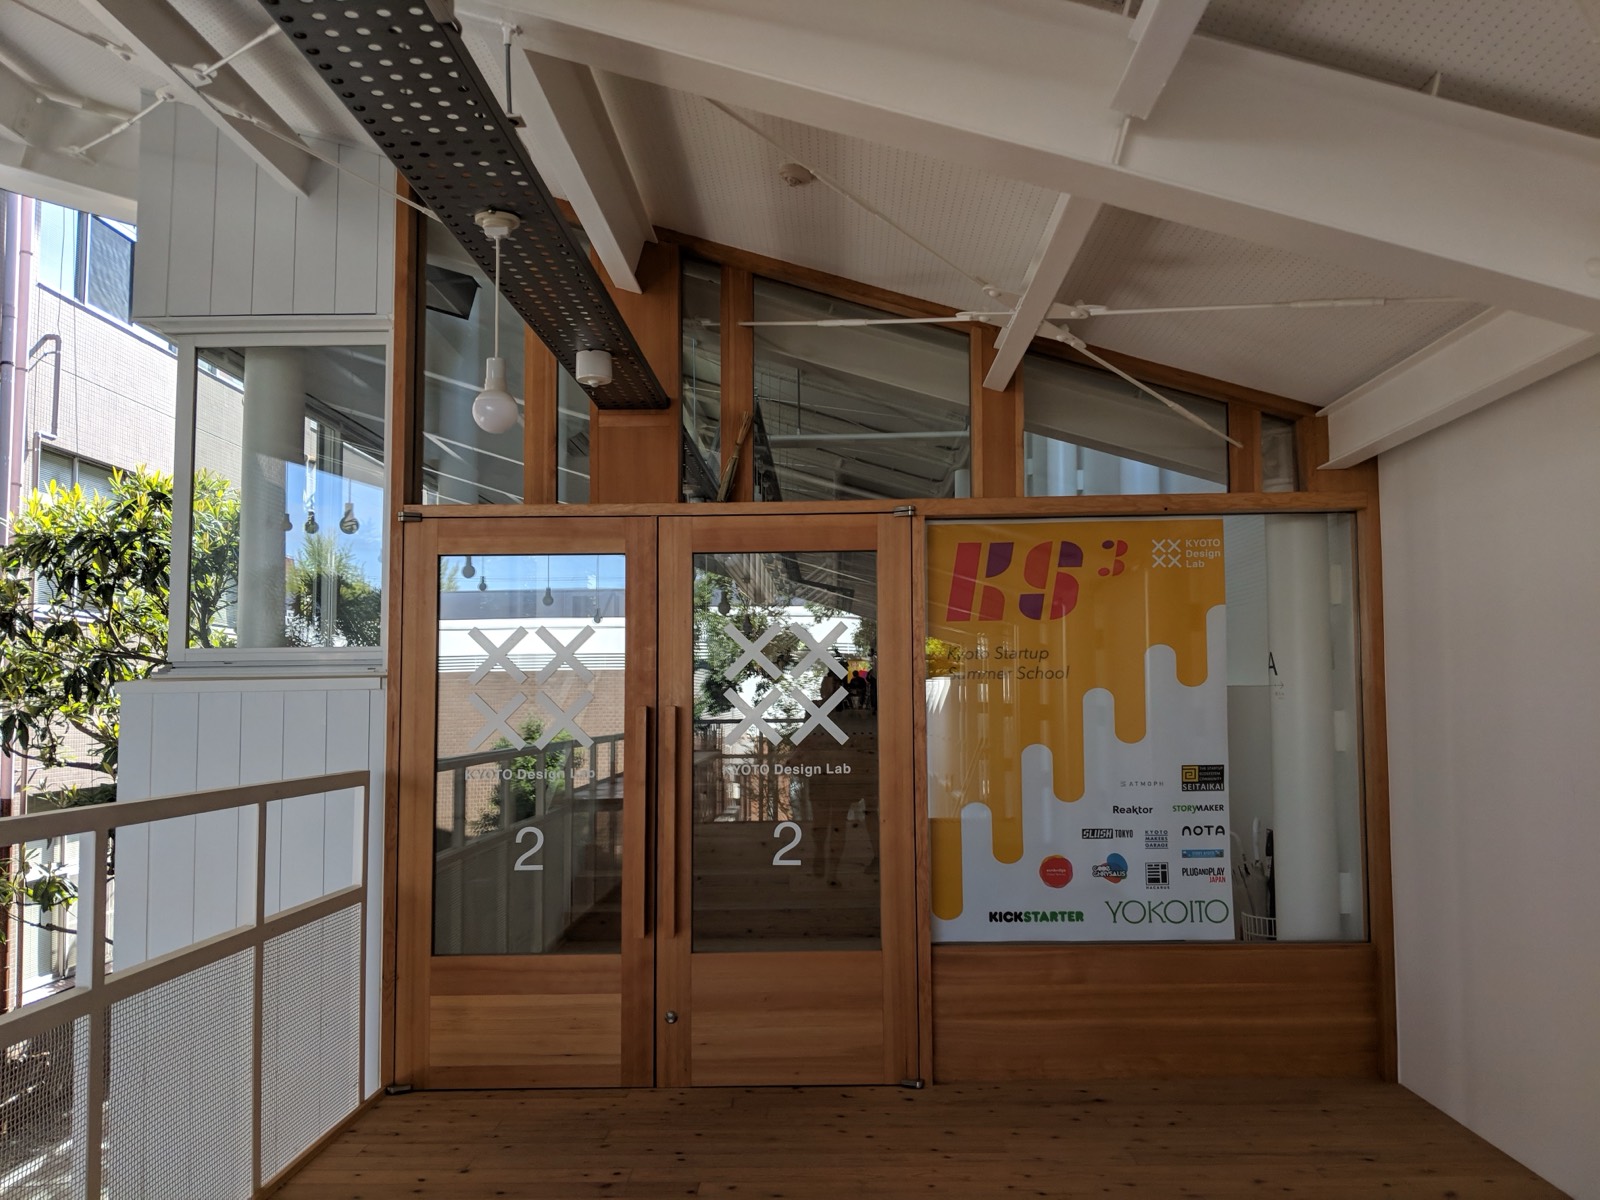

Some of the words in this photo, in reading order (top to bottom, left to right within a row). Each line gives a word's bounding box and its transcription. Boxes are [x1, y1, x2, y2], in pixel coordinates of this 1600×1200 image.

[1185, 538, 1221, 548] KYOTO
[1185, 549, 1221, 560] Design
[1185, 560, 1205, 568] Lab
[994, 646, 1050, 663] Startup
[1016, 665, 1070, 680] School
[517, 768, 565, 781] Design
[721, 764, 770, 776] KYOTO
[774, 763, 822, 778] Design
[826, 763, 852, 775] Lab
[1182, 783, 1224, 791] SEITAIKAI
[1112, 805, 1153, 815] Reaktor
[1082, 829, 1113, 839] SLUSH
[1115, 829, 1134, 838] TOKYO
[514, 826, 544, 871] 2
[772, 821, 802, 866] 2
[989, 911, 1084, 923] KICKSTARTER
[1104, 899, 1229, 924] YOKOITO
